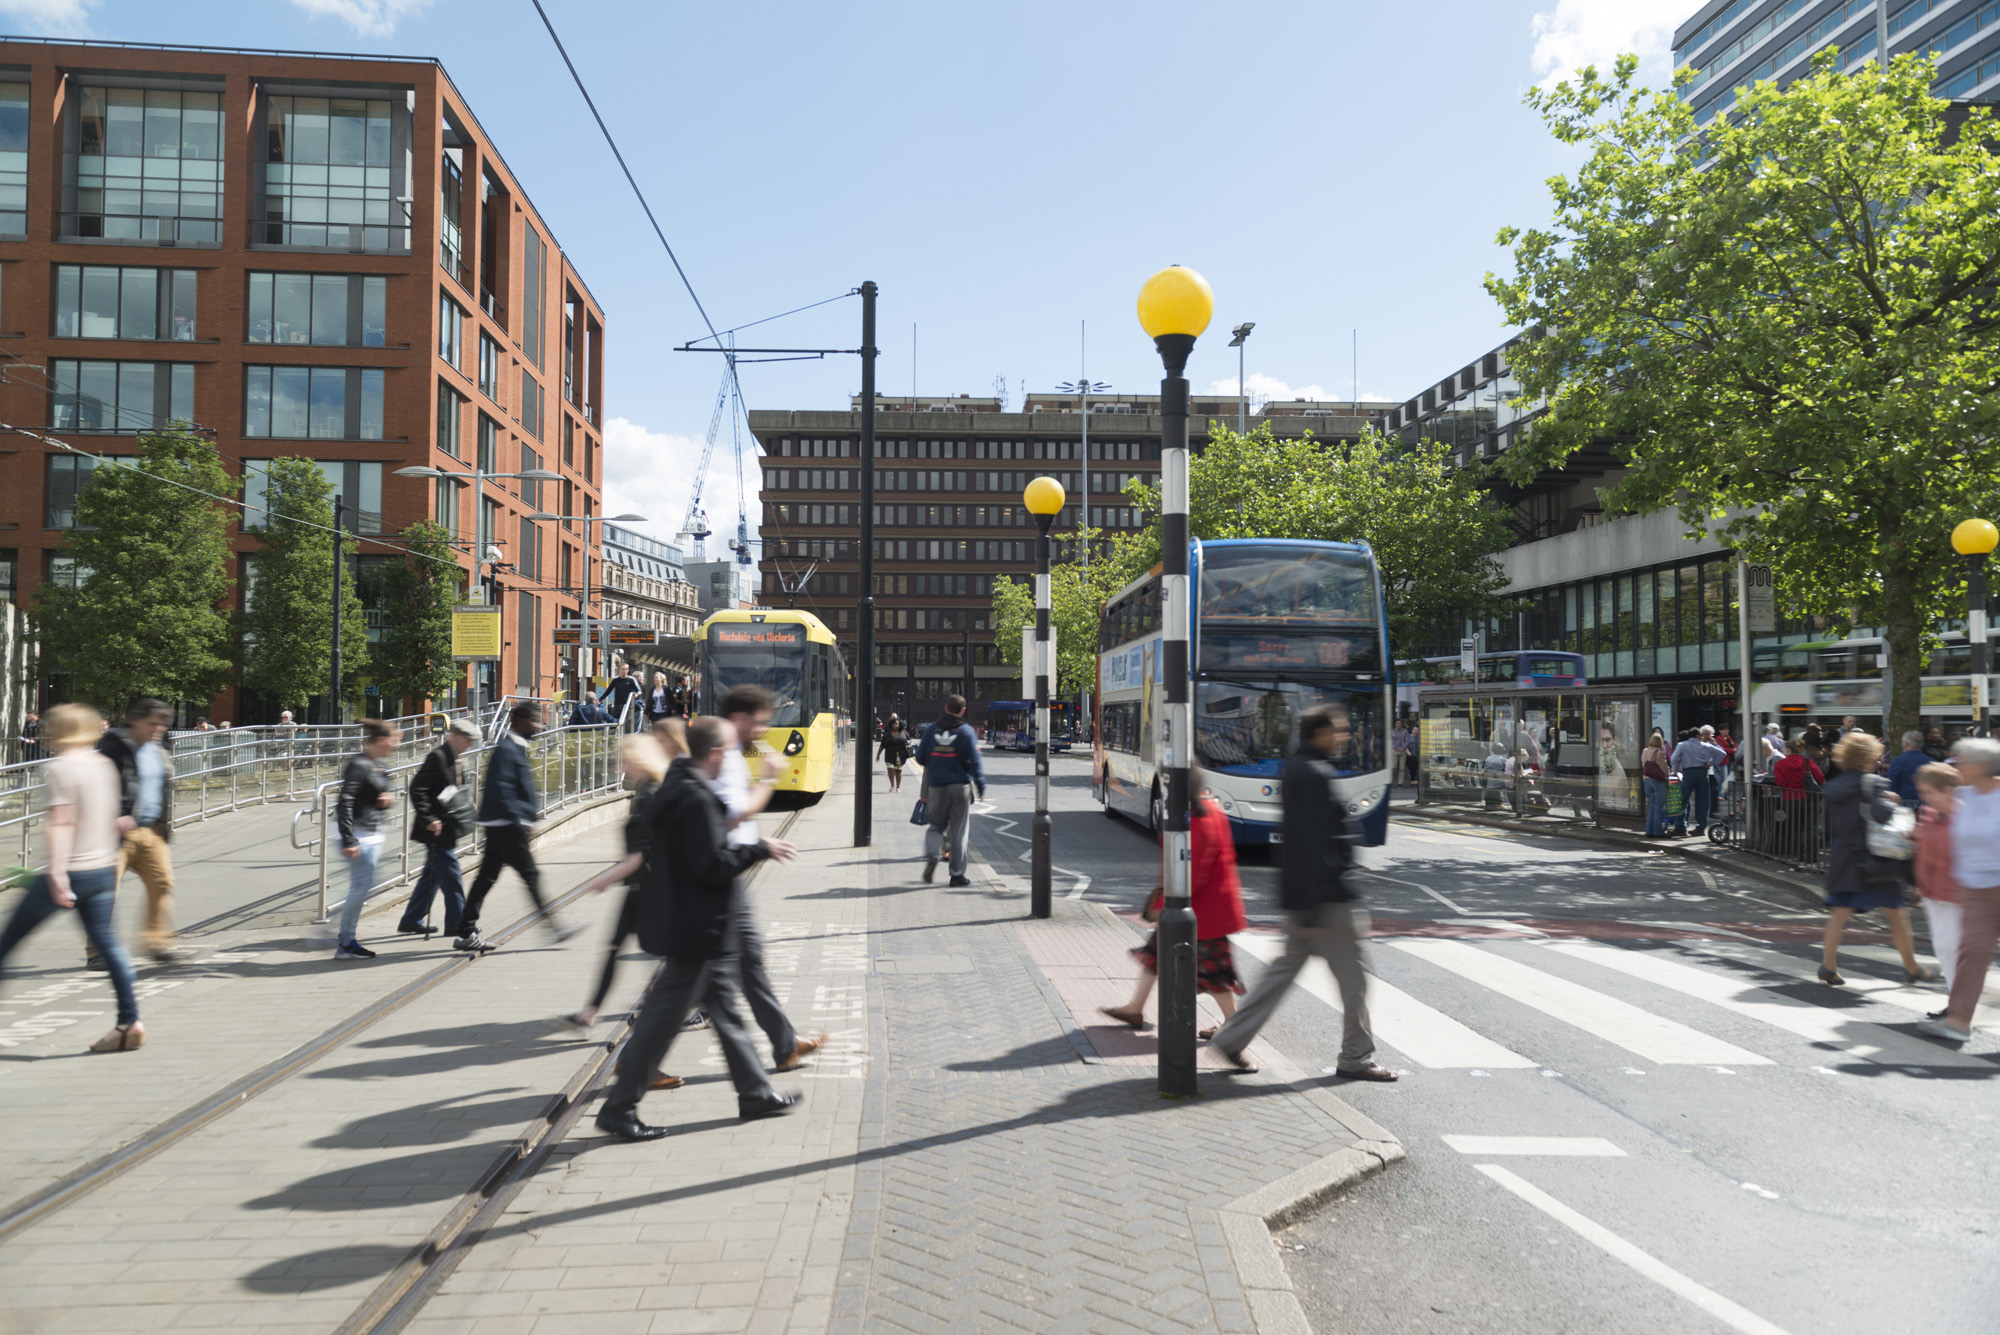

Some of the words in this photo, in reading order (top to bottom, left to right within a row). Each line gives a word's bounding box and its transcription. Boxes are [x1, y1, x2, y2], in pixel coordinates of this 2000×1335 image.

[720, 631, 752, 642] Rochdale
[752, 632, 765, 642] via
[766, 631, 796, 642] Victoria
[1258, 641, 1289, 653] Sorry
[1319, 642, 1348, 665] 000
[1271, 653, 1305, 664] Service
[1692, 682, 1735, 696] NOBLES
[809, 985, 863, 1021] LEFT
[800, 1028, 863, 1078] LOOK
